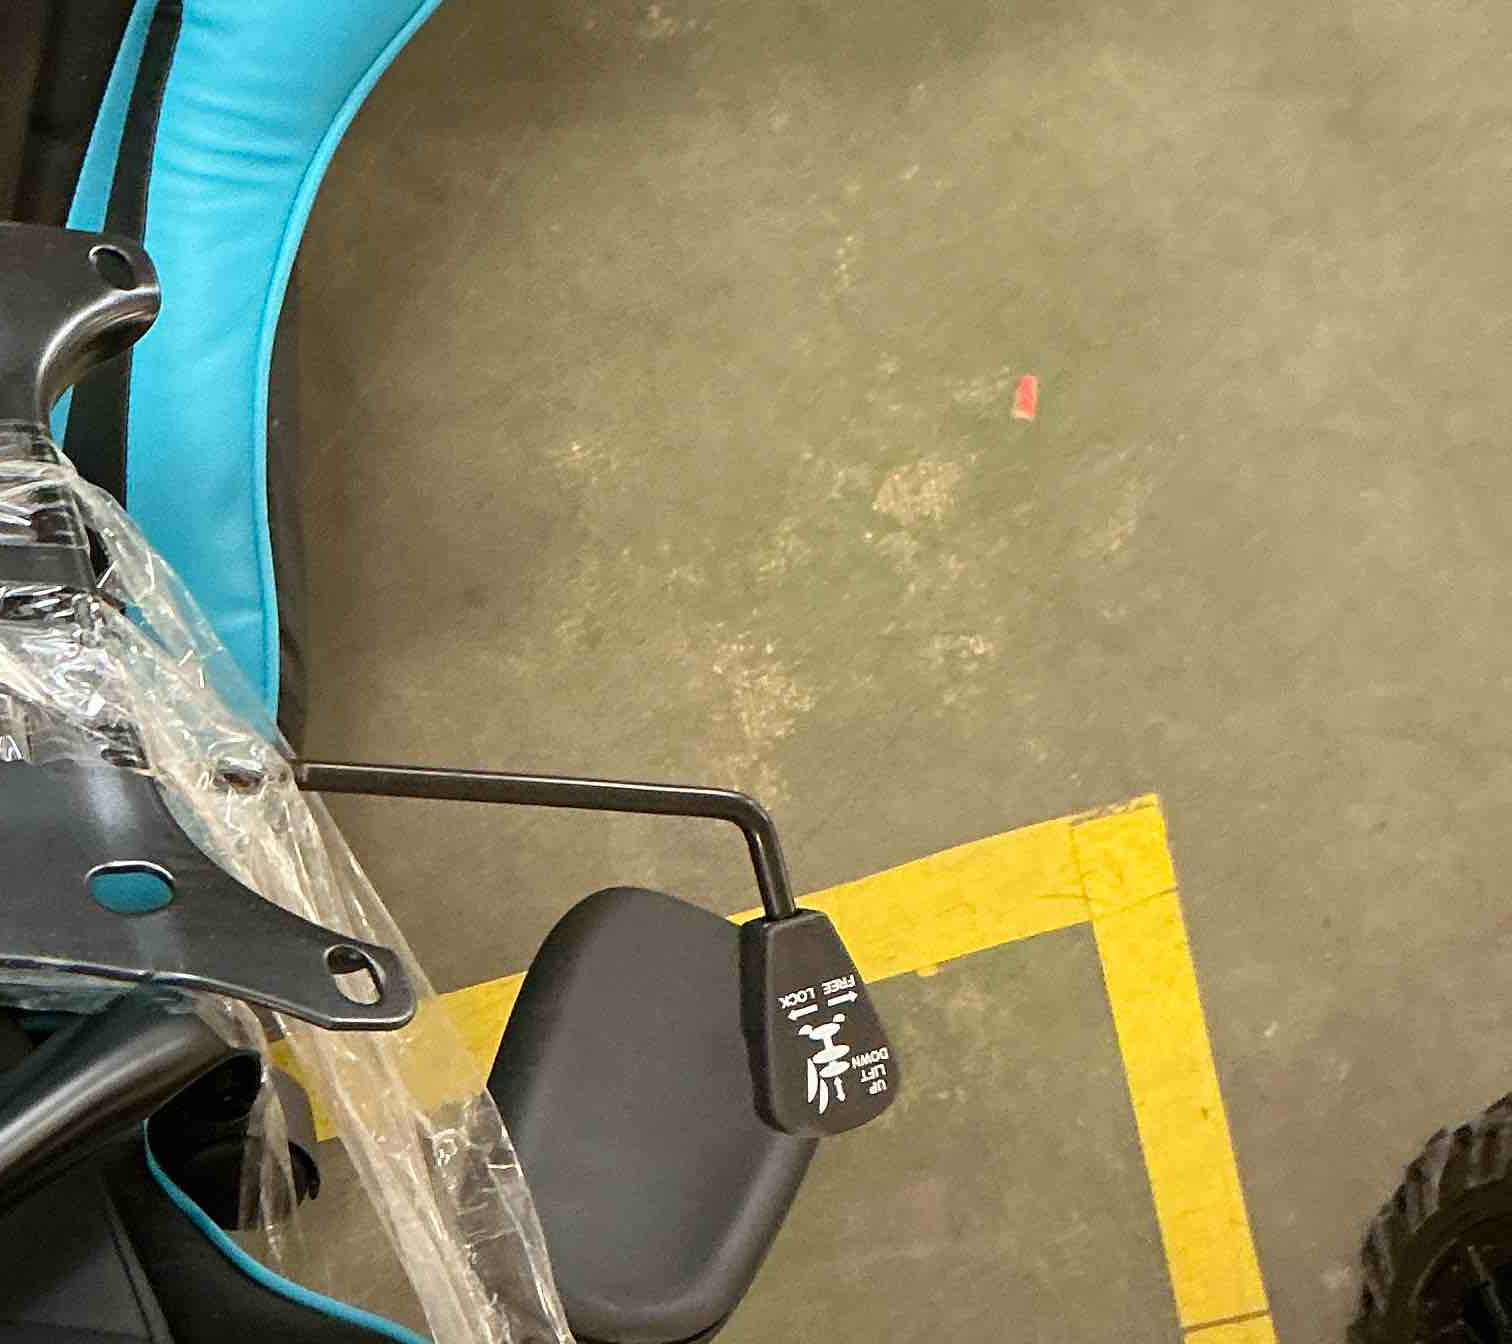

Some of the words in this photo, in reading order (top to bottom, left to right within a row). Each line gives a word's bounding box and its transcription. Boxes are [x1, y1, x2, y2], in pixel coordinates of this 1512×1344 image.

[822, 975, 855, 995] FREE
[778, 988, 815, 1008] LOCK
[851, 1047, 888, 1068] DOWN
[860, 1064, 886, 1083] LIFT
[869, 1079, 887, 1095] UP
